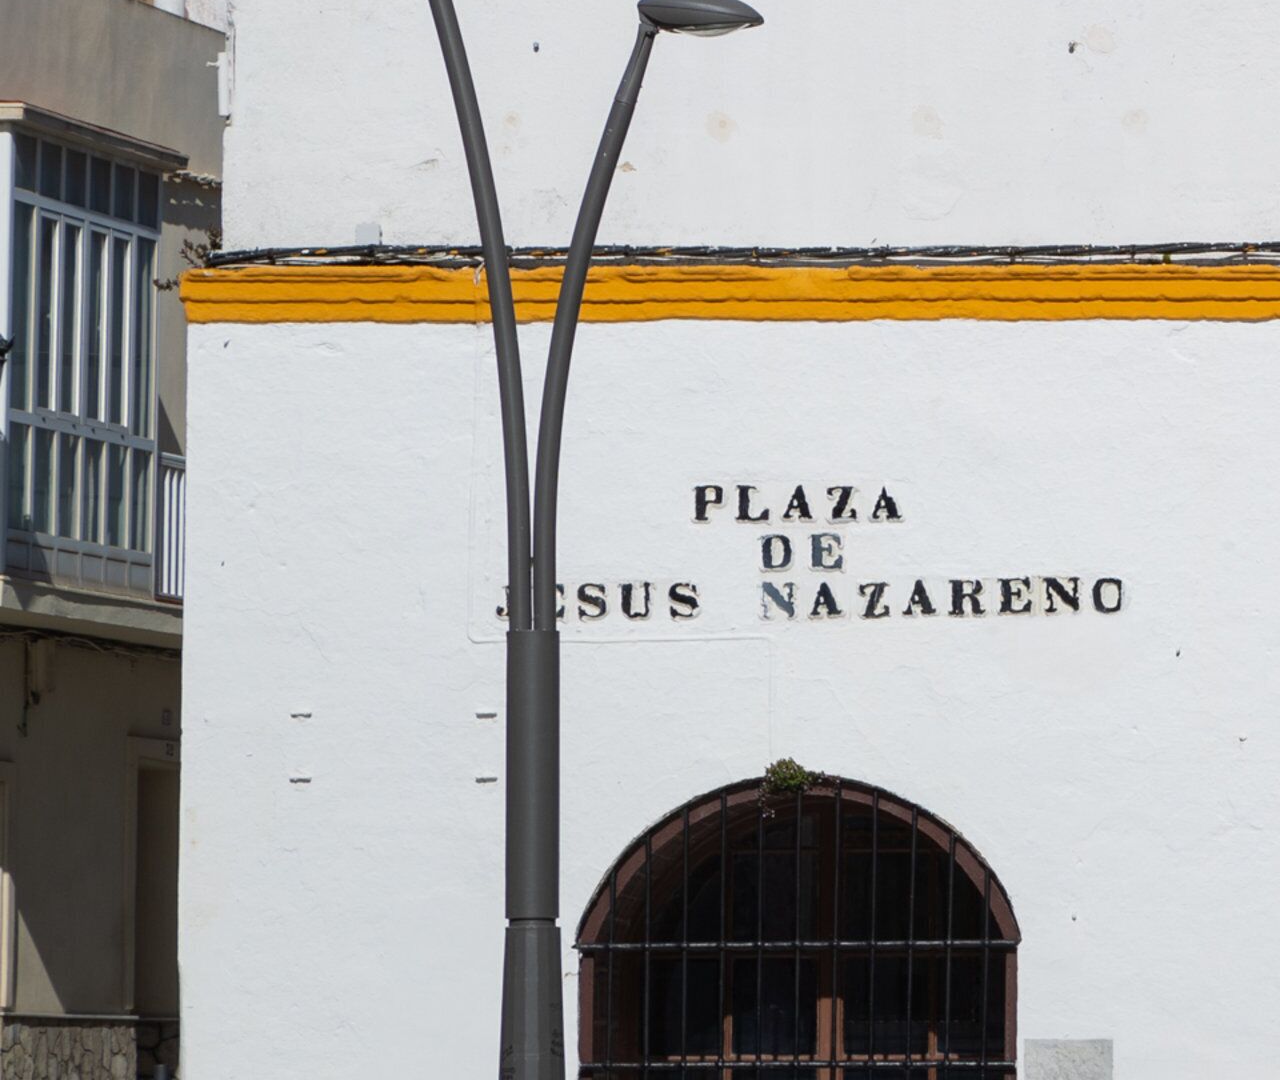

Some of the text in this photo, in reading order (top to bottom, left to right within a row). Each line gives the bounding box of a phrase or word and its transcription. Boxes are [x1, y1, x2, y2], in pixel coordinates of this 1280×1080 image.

[693, 484, 904, 522] PLAZA
[758, 532, 845, 571] DE
[760, 576, 1124, 619] NAZARENO
